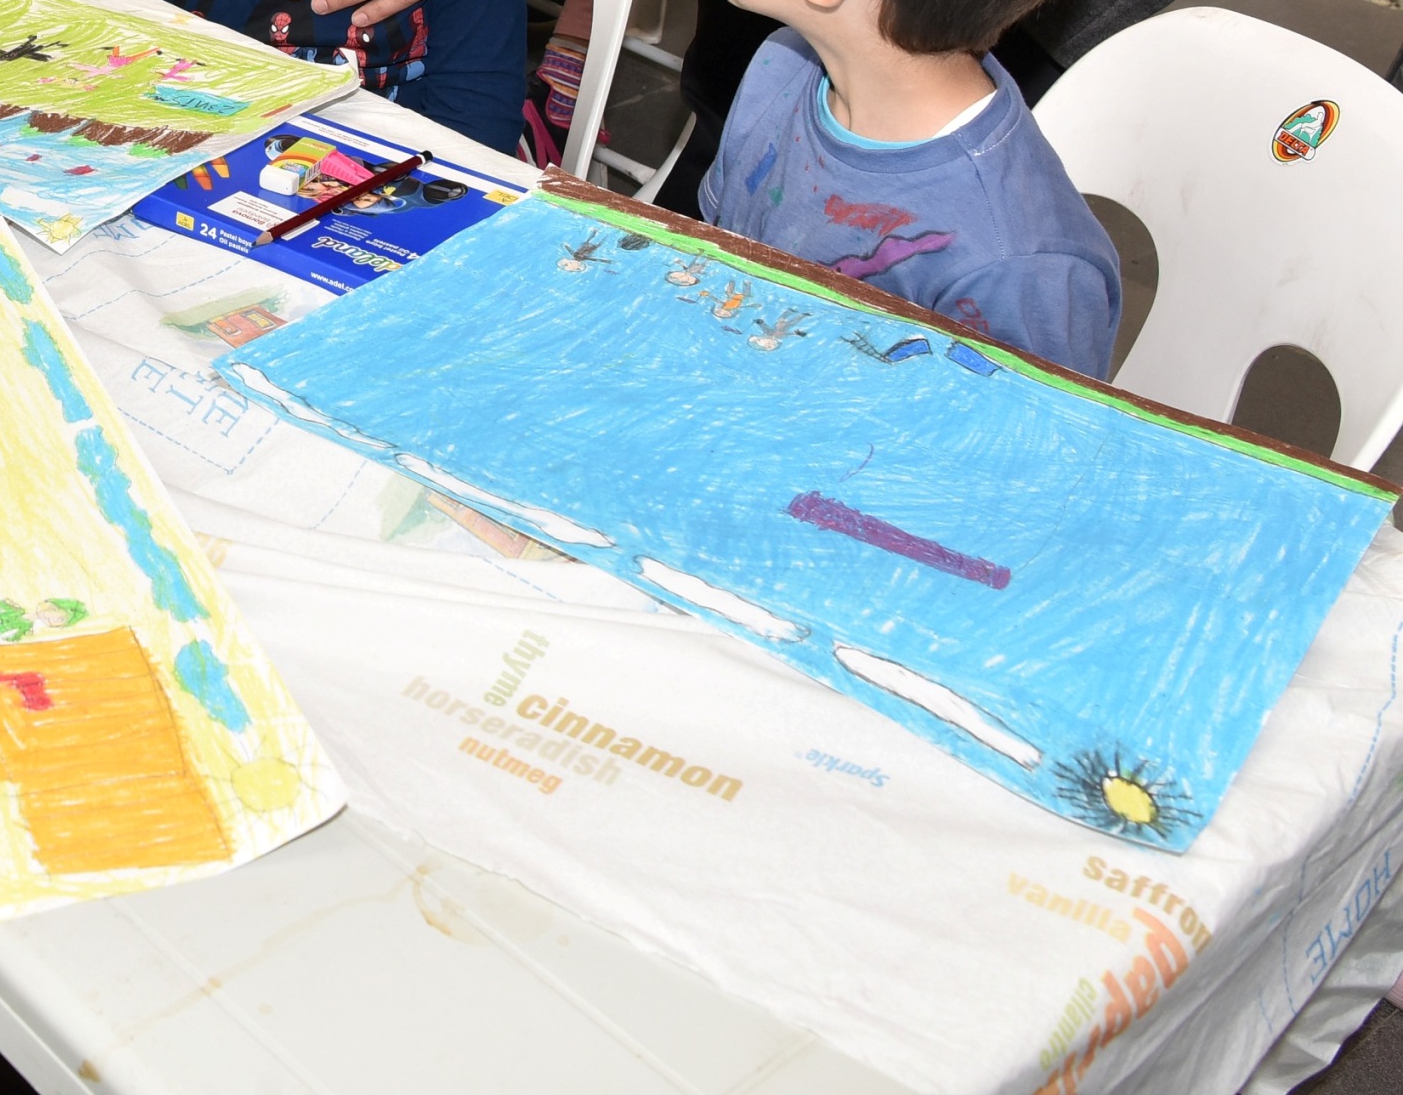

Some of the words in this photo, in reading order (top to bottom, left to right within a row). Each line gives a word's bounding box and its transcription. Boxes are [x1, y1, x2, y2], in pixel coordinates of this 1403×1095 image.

[1278, 131, 1310, 156] DELTA
[199, 223, 217, 240] 24
[219, 229, 238, 241] Pastel
[219, 237, 228, 245] Oil
[228, 241, 249, 254] pastels
[311, 236, 402, 272] deland
[310, 271, 355, 293] www.adel.co
[483, 629, 550, 708] thyme
[402, 675, 623, 787] horseradish
[517, 692, 744, 803] cinnamon
[458, 734, 564, 796] nutmeg
[805, 748, 891, 788] Sparkle
[1006, 871, 1132, 945] vanilla
[1082, 855, 1213, 954] saffron
[1305, 848, 1391, 985] HOME
